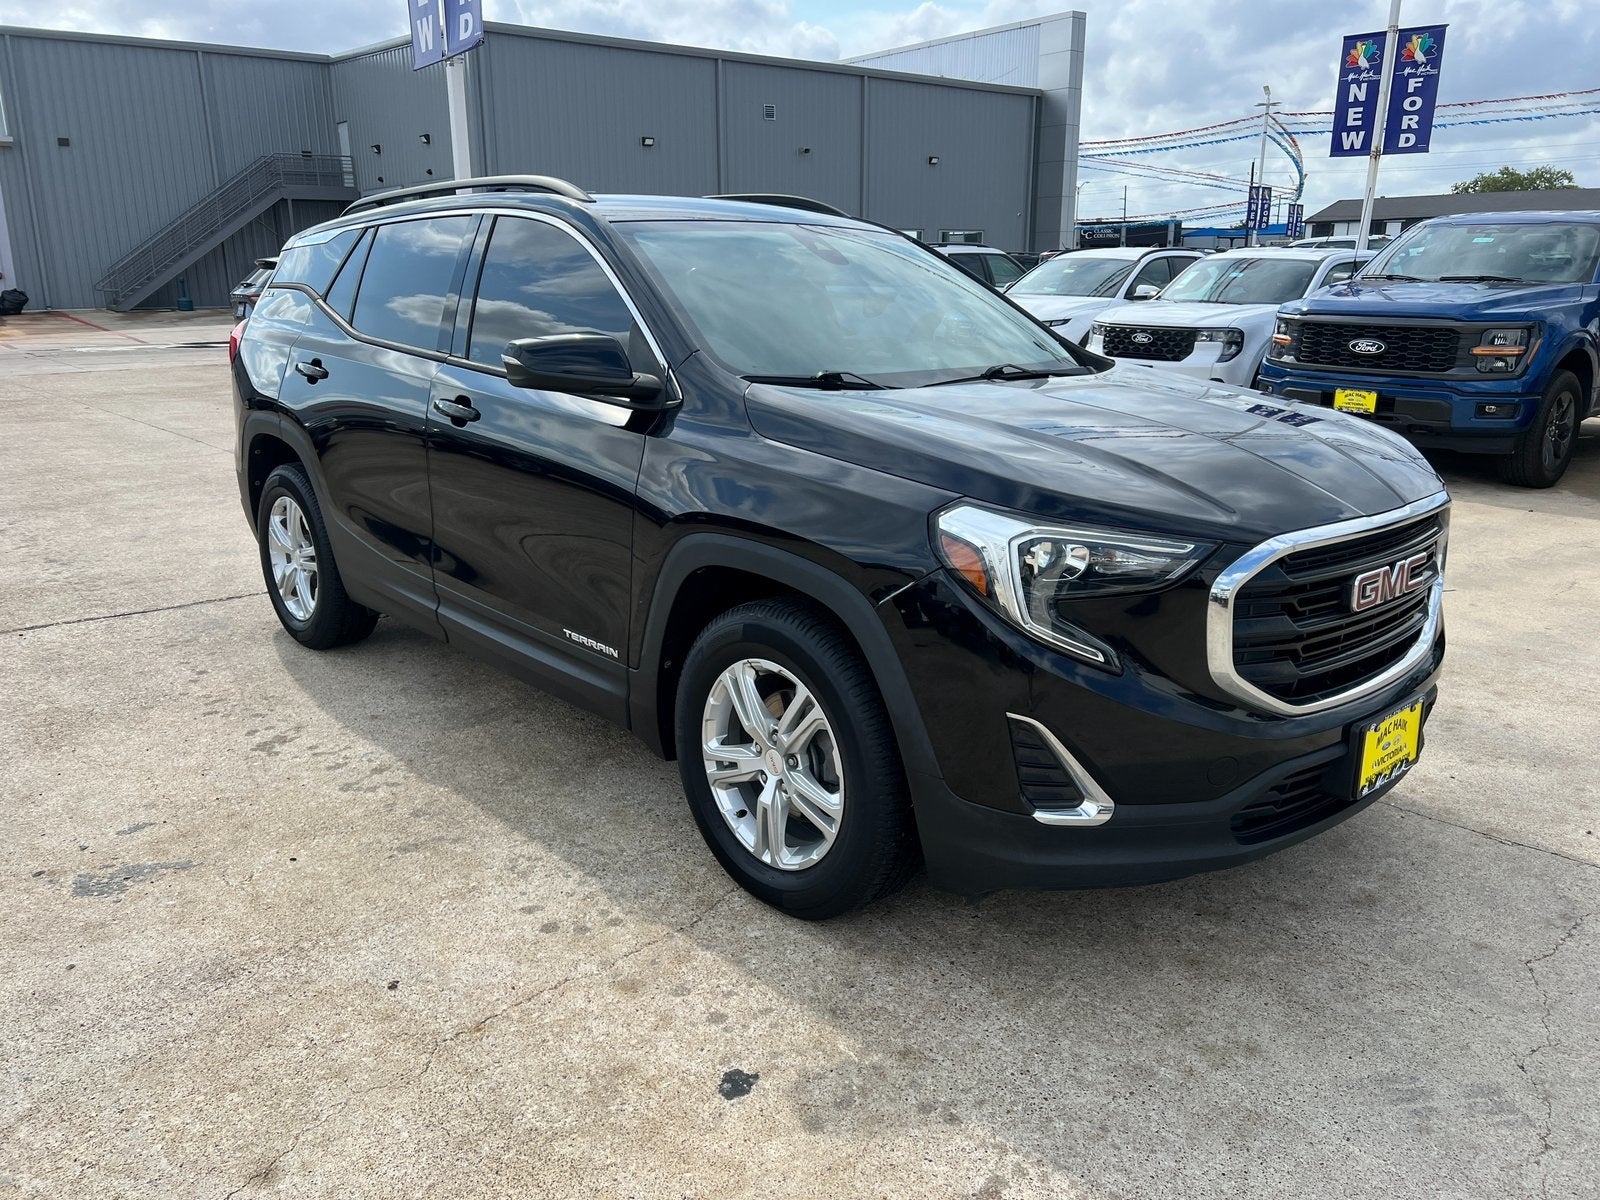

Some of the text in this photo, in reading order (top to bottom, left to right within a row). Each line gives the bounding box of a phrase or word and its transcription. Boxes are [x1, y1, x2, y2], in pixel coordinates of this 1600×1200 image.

[1341, 82, 1368, 150] NEW
[1398, 78, 1424, 148] FORD
[1248, 203, 1257, 228] NEW
[1261, 203, 1269, 229] FORD
[1354, 552, 1427, 612] GMC
[563, 628, 619, 659] TERRAIN
[1376, 722, 1393, 749] MAC
[1393, 718, 1408, 732] HAIK
